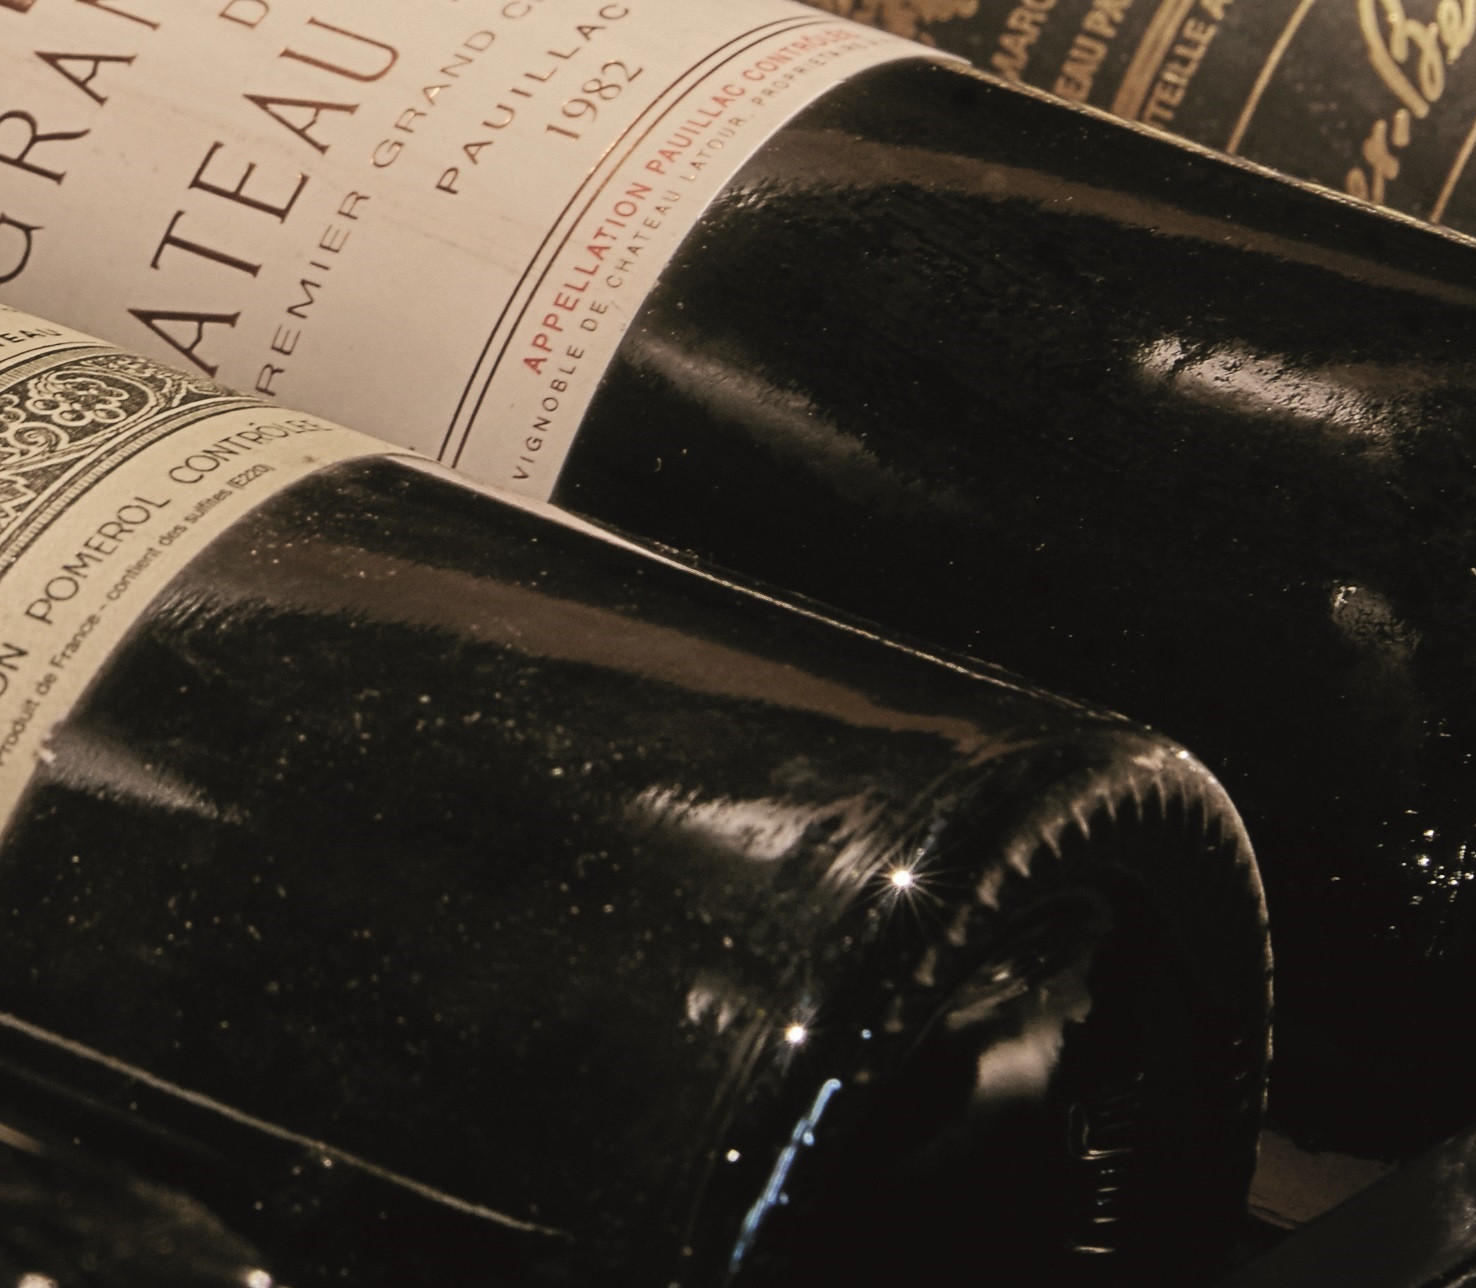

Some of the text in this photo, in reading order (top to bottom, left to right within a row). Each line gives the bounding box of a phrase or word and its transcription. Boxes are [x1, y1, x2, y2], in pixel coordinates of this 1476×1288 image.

[435, 3, 631, 195] PAUILLAC
[545, 59, 646, 141] 1982
[1149, 17, 1217, 128] TEILLE
[128, 17, 399, 377] ATEAU
[254, 27, 498, 397] REMIER GRAND
[521, 181, 653, 375] APPELLATION
[645, 83, 746, 176] PAUILLAC
[511, 345, 585, 482] VIGNOBLE
[580, 301, 609, 333] DE
[605, 190, 681, 290] CHATEAU
[25, 494, 172, 626] POMEROL
[36, 668, 59, 697] de
[49, 613, 102, 672] France
[106, 541, 163, 601] contient
[159, 524, 188, 547] des
[184, 487, 234, 525] sulfites
